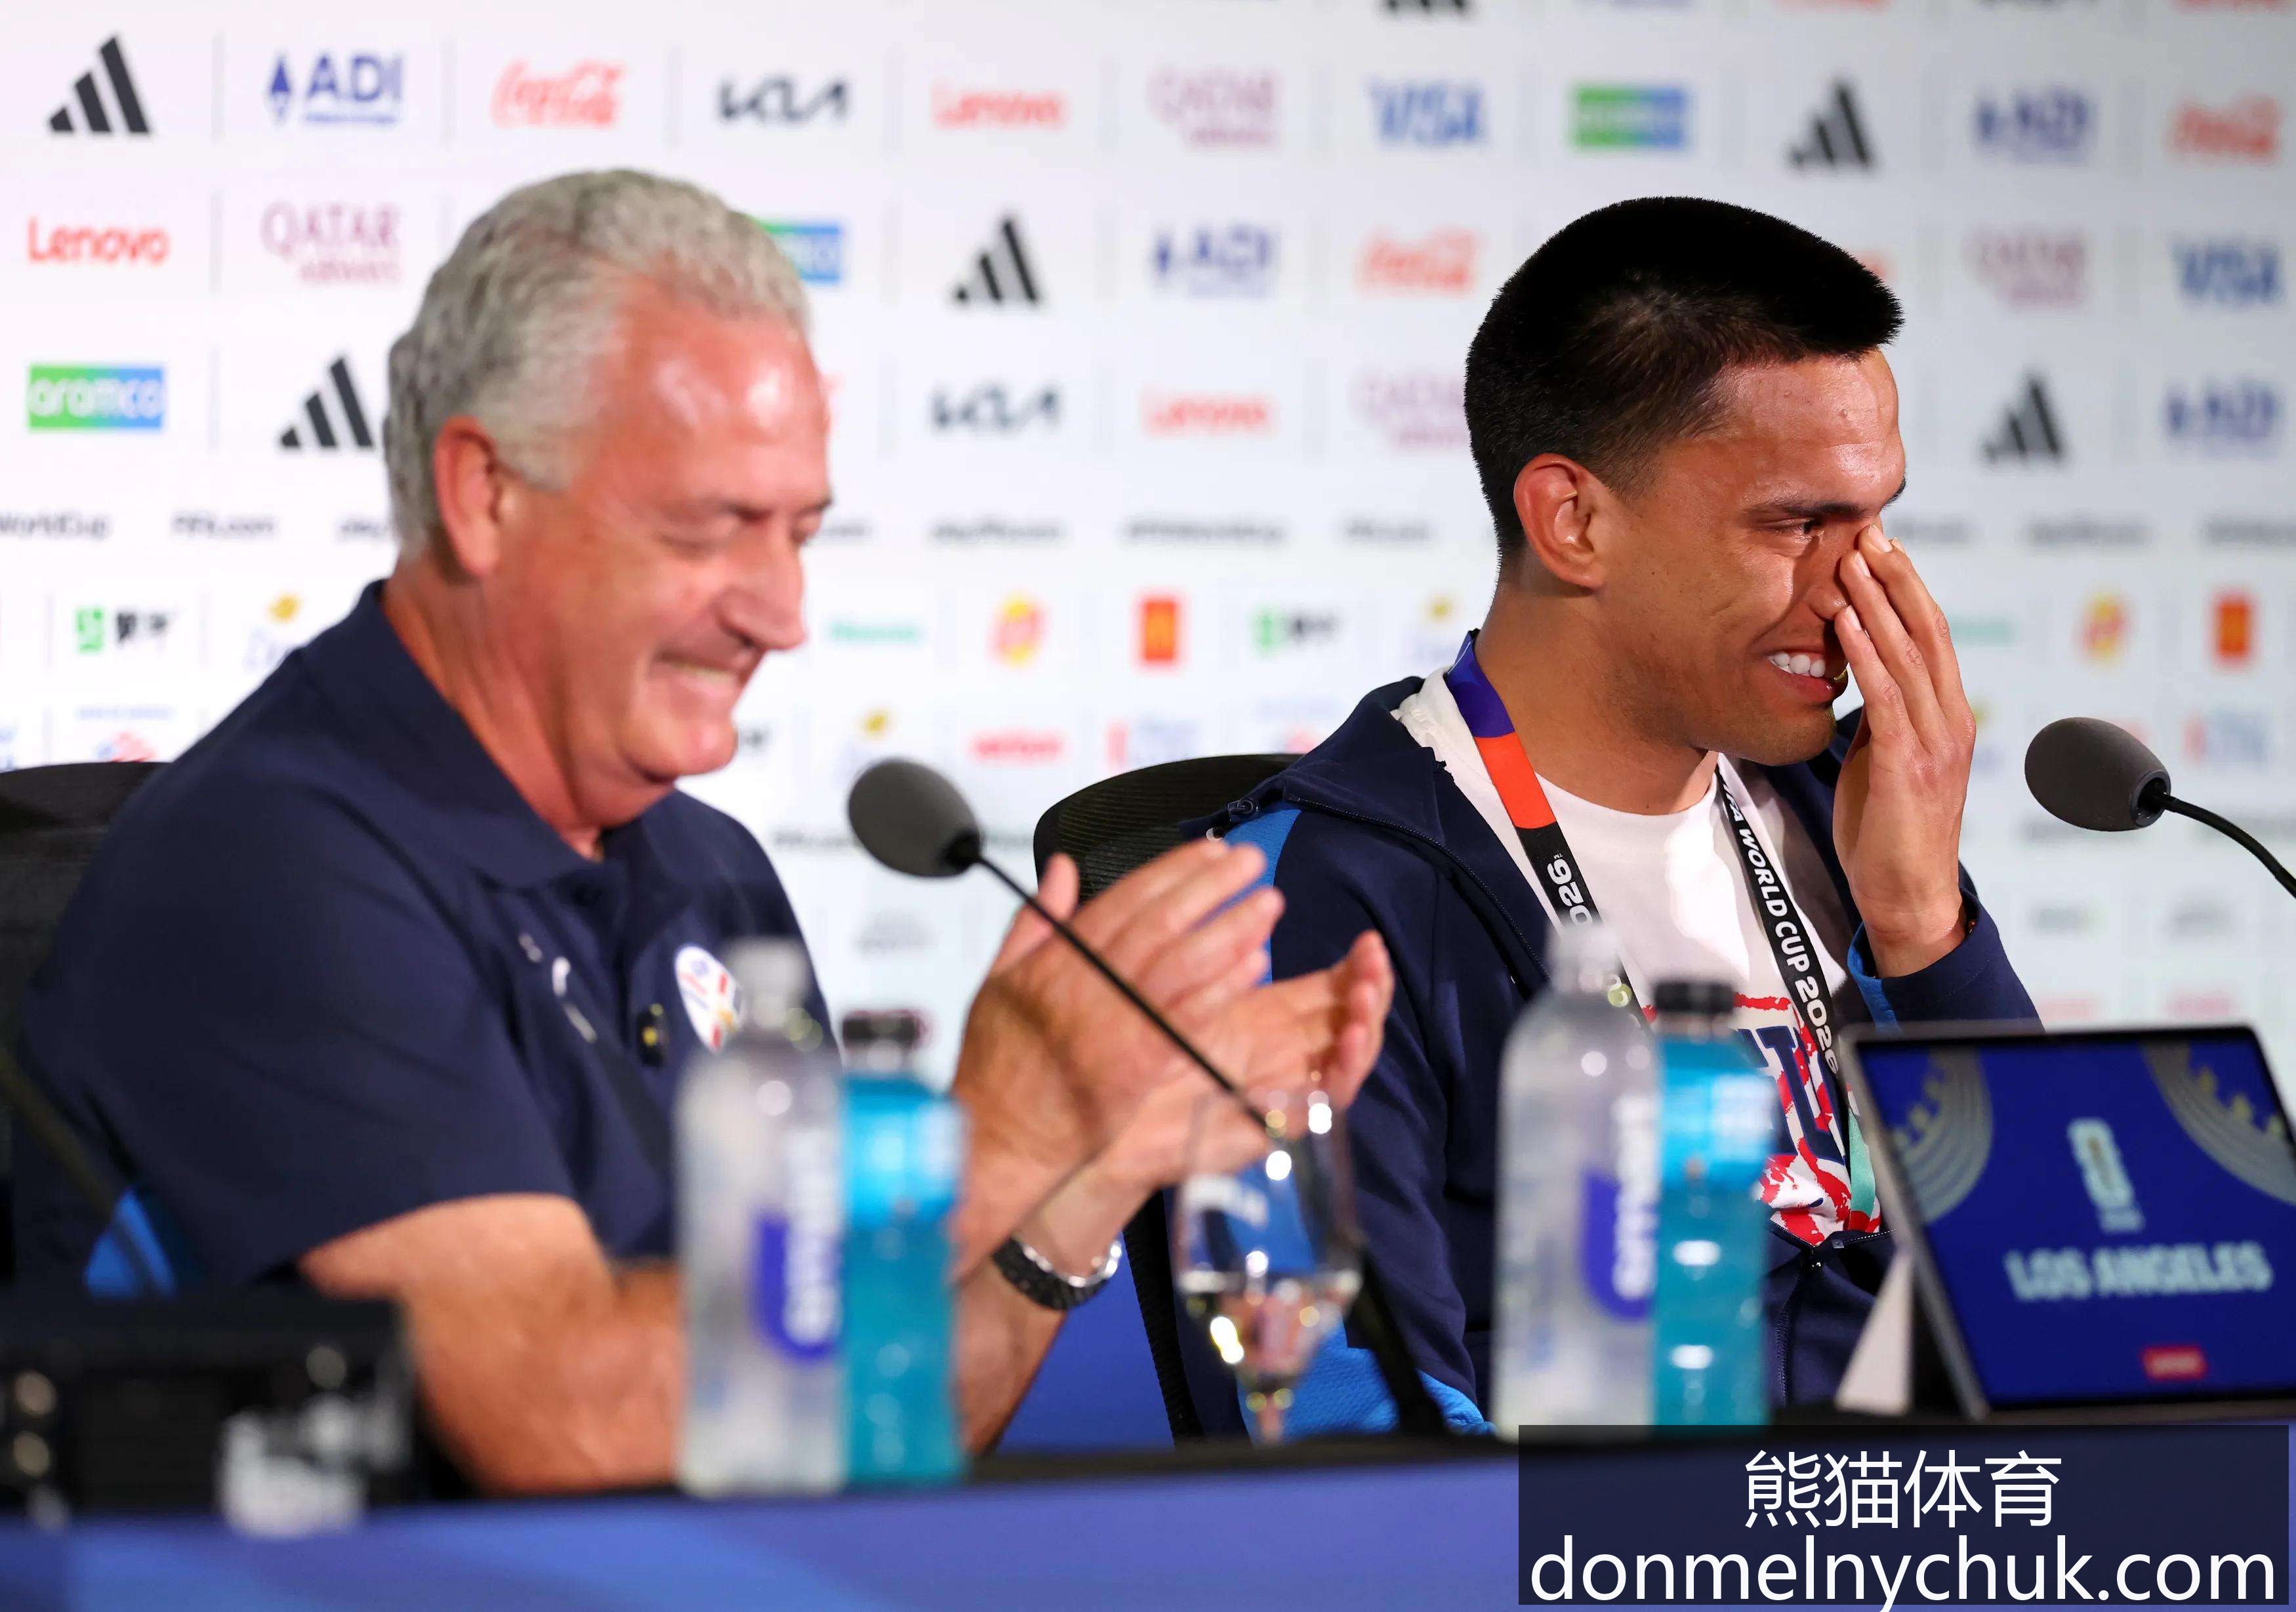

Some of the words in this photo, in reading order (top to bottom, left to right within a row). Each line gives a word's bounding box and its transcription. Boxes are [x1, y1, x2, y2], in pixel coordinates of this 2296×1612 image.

[306, 54, 402, 102] ADI
[28, 218, 169, 264] Lenovo
[263, 202, 399, 256] QATAR
[28, 379, 163, 417] aramco
[1739, 828, 1788, 917] WORLD
[1775, 921, 1810, 972] CUP
[1795, 976, 1838, 1075] 2026
[2005, 1249, 2092, 1300] LOS
[2093, 1241, 2274, 1297] ANGELES
